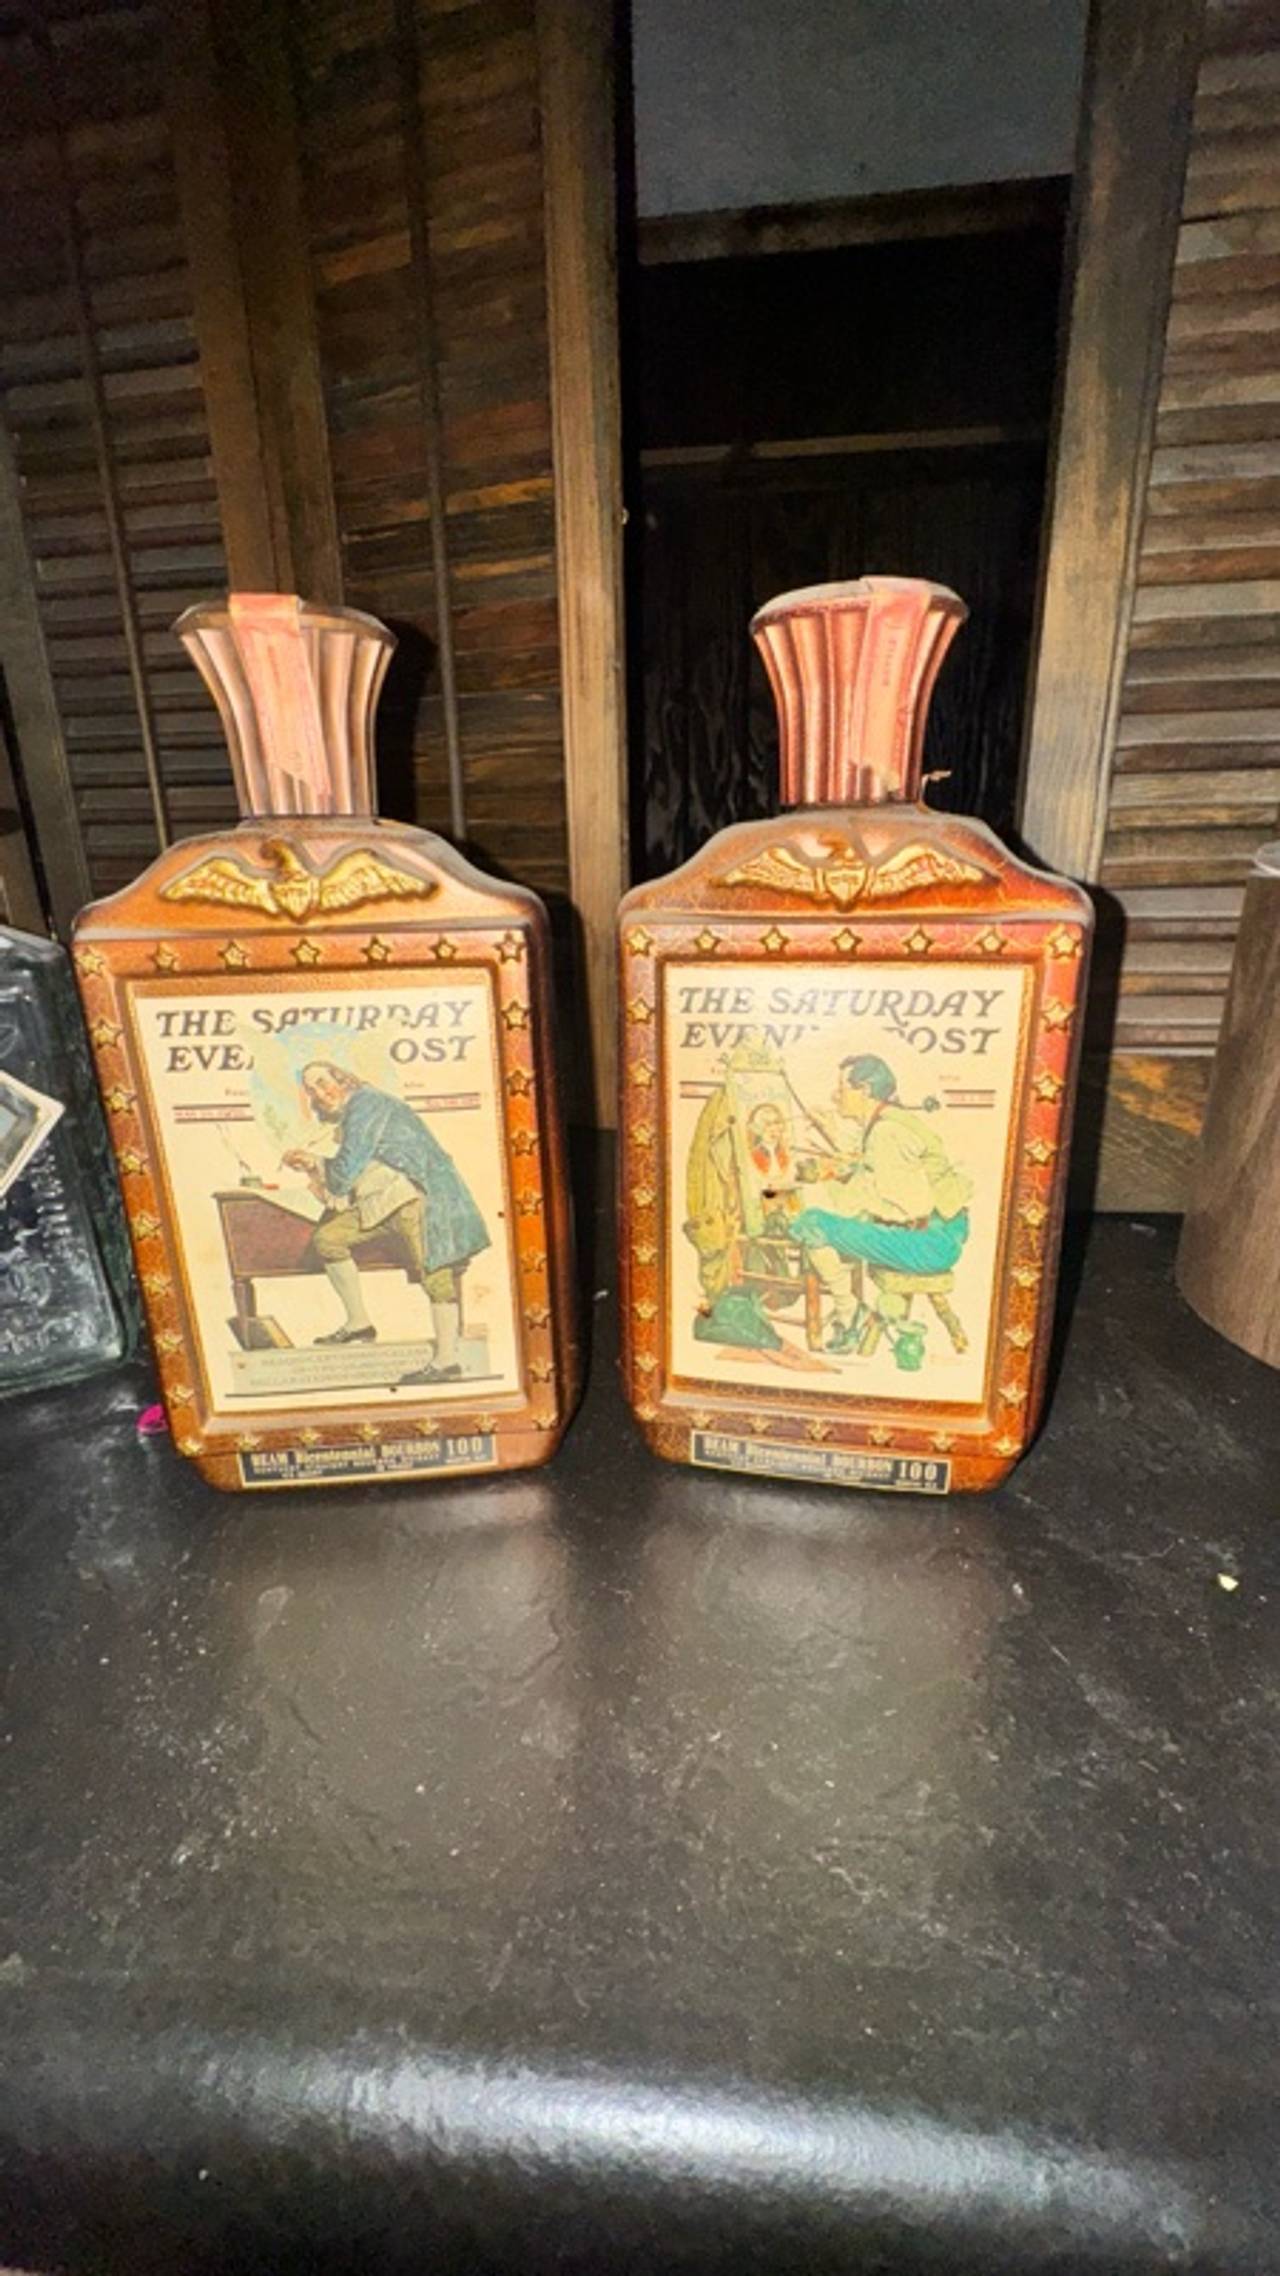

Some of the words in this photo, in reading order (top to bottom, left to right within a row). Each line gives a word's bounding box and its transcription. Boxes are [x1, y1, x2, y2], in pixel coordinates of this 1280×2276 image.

[679, 986, 754, 1014] THE
[768, 987, 1005, 1027] SATURDAY
[156, 1009, 236, 1037] THE
[882, 1026, 1002, 1054] OST
[165, 1044, 254, 1072] EVE
[446, 1437, 483, 1455] 100
[899, 1461, 938, 1481] 100
